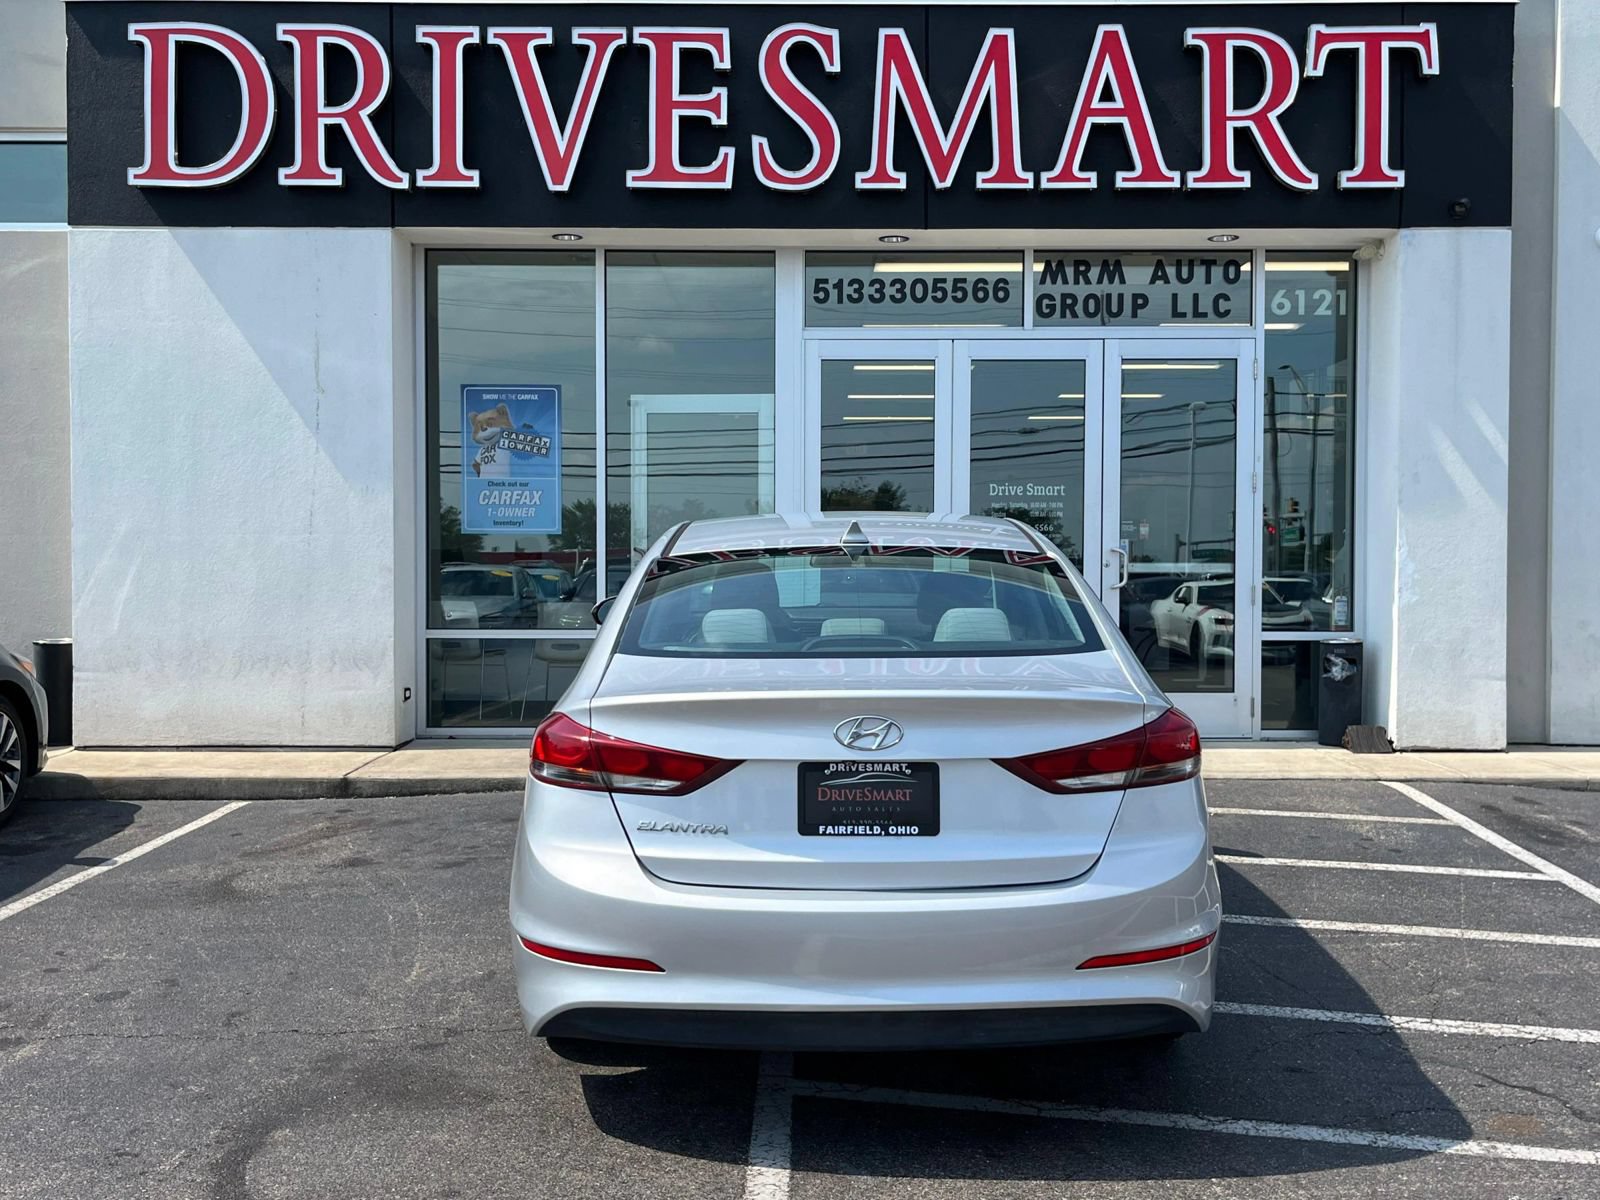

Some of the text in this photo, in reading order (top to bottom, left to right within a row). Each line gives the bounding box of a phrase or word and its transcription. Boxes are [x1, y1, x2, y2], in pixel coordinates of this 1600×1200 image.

[126, 21, 1440, 193] DRIVESMART
[1038, 258, 1241, 285] MRM AUTO
[812, 277, 1010, 305] 5133305566
[1035, 292, 1232, 319] GROUP LLC
[1270, 288, 1347, 316] 6121
[502, 431, 551, 447] CARFAX
[508, 441, 548, 455] OWNER
[479, 489, 542, 505] CARFAX
[989, 482, 1066, 496] Drive Smart
[487, 506, 536, 517] 1-OWNER
[493, 519, 524, 528] Inventory!
[829, 762, 909, 772] DRIVESMART
[637, 820, 729, 836] ELANTRA
[818, 825, 920, 836] FAIRFIELD, OHIO
